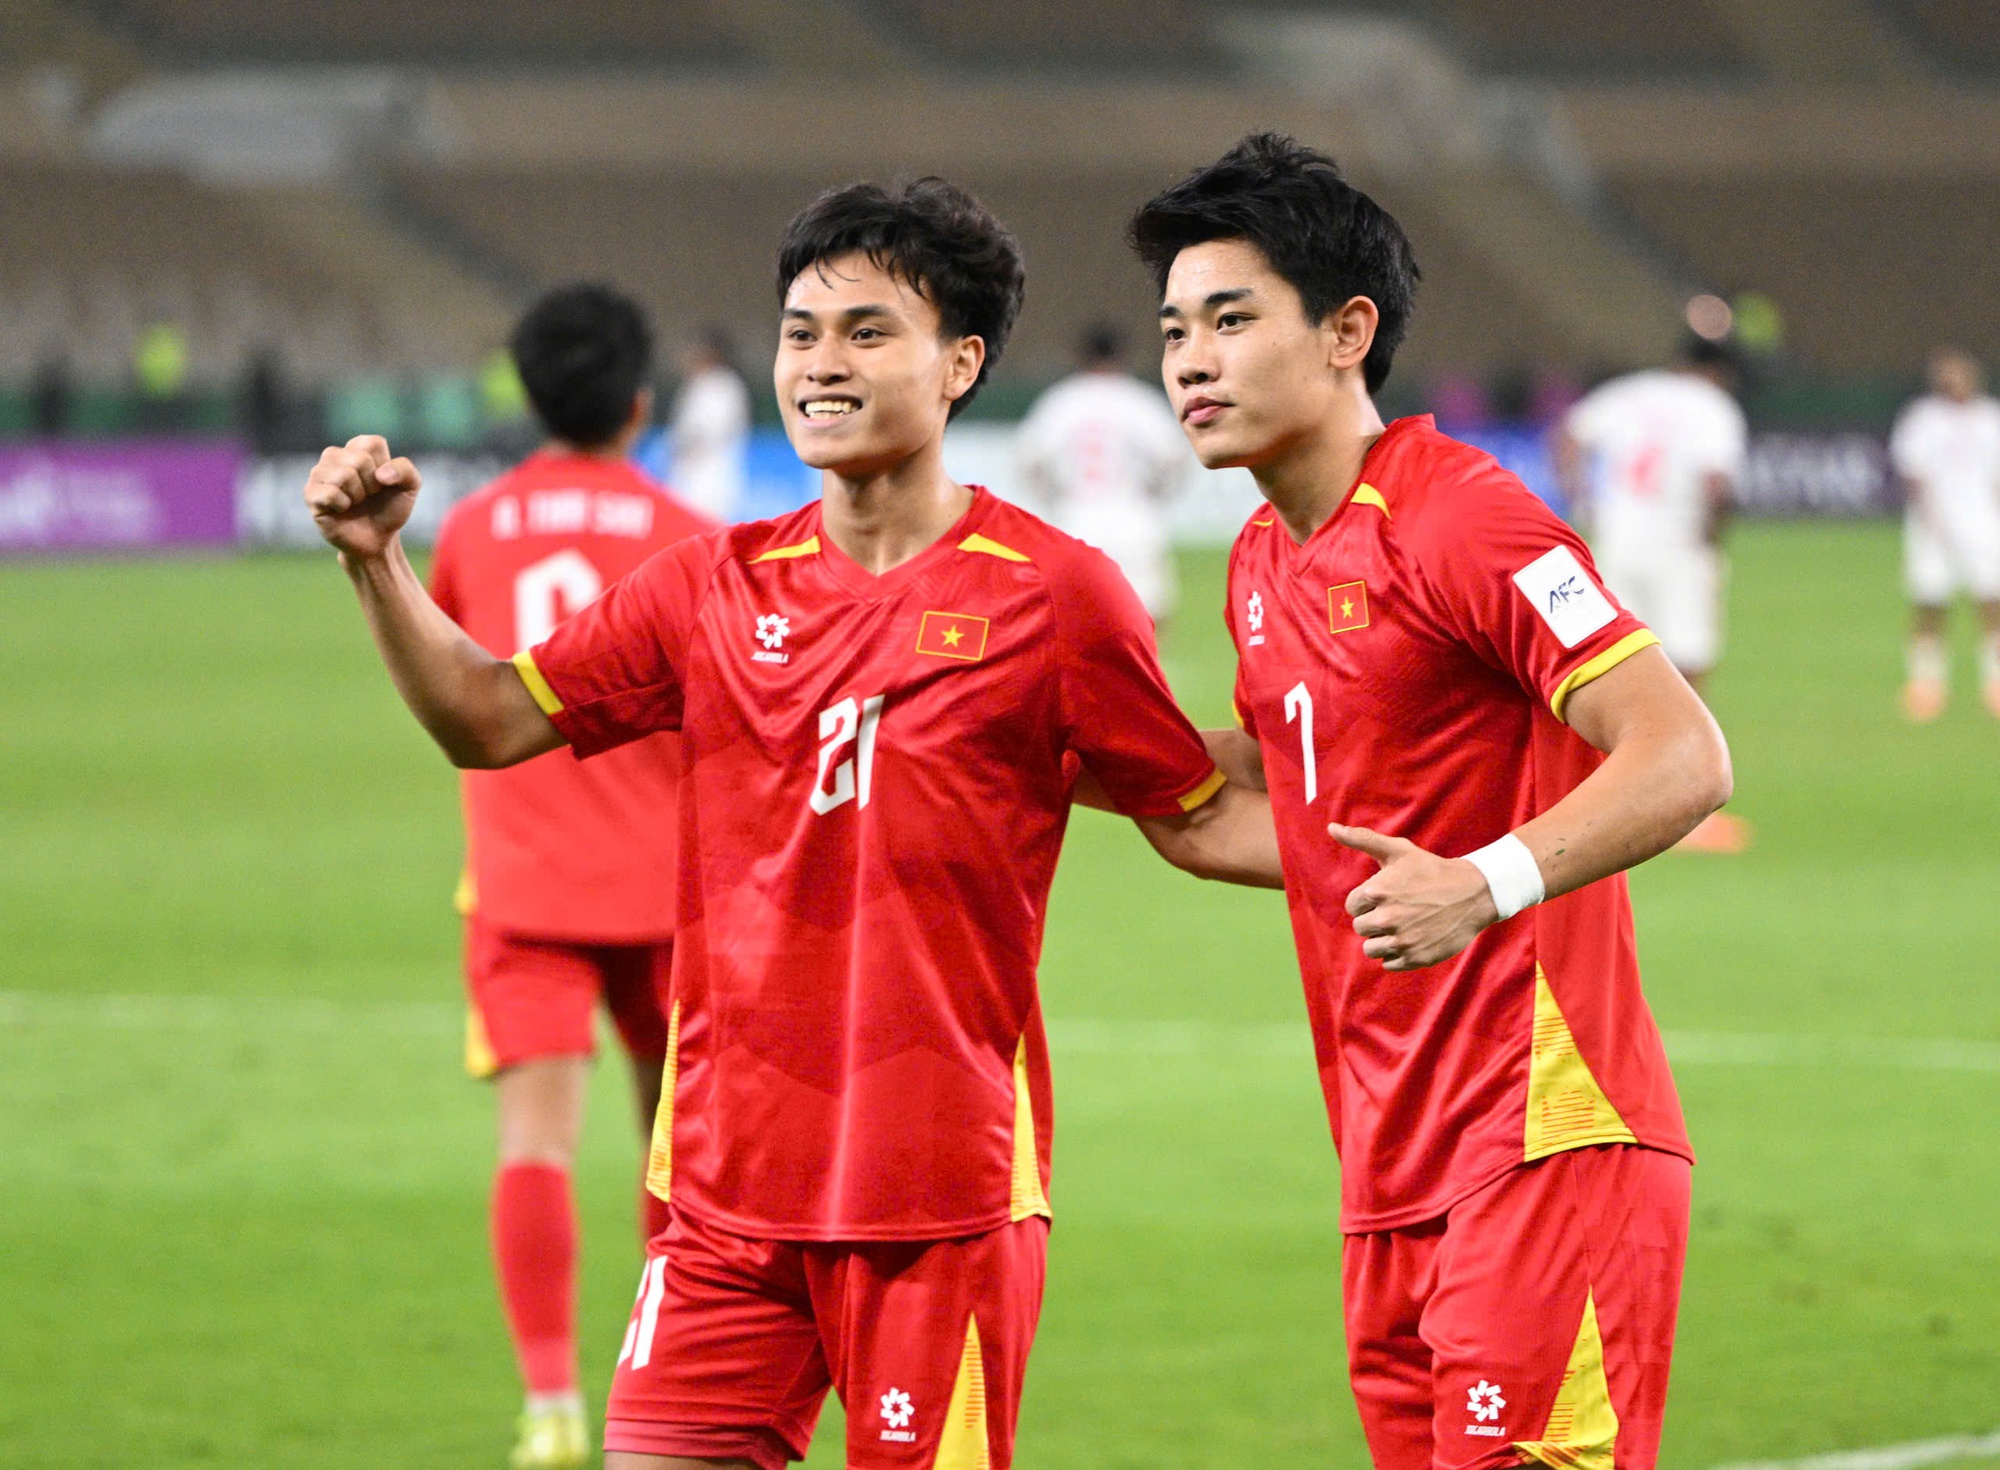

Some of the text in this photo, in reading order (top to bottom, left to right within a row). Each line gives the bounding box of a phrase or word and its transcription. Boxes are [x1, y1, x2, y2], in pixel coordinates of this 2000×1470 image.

[1550, 575, 1584, 614] AFC
[809, 694, 886, 816] 21
[1284, 681, 1317, 806] 7
